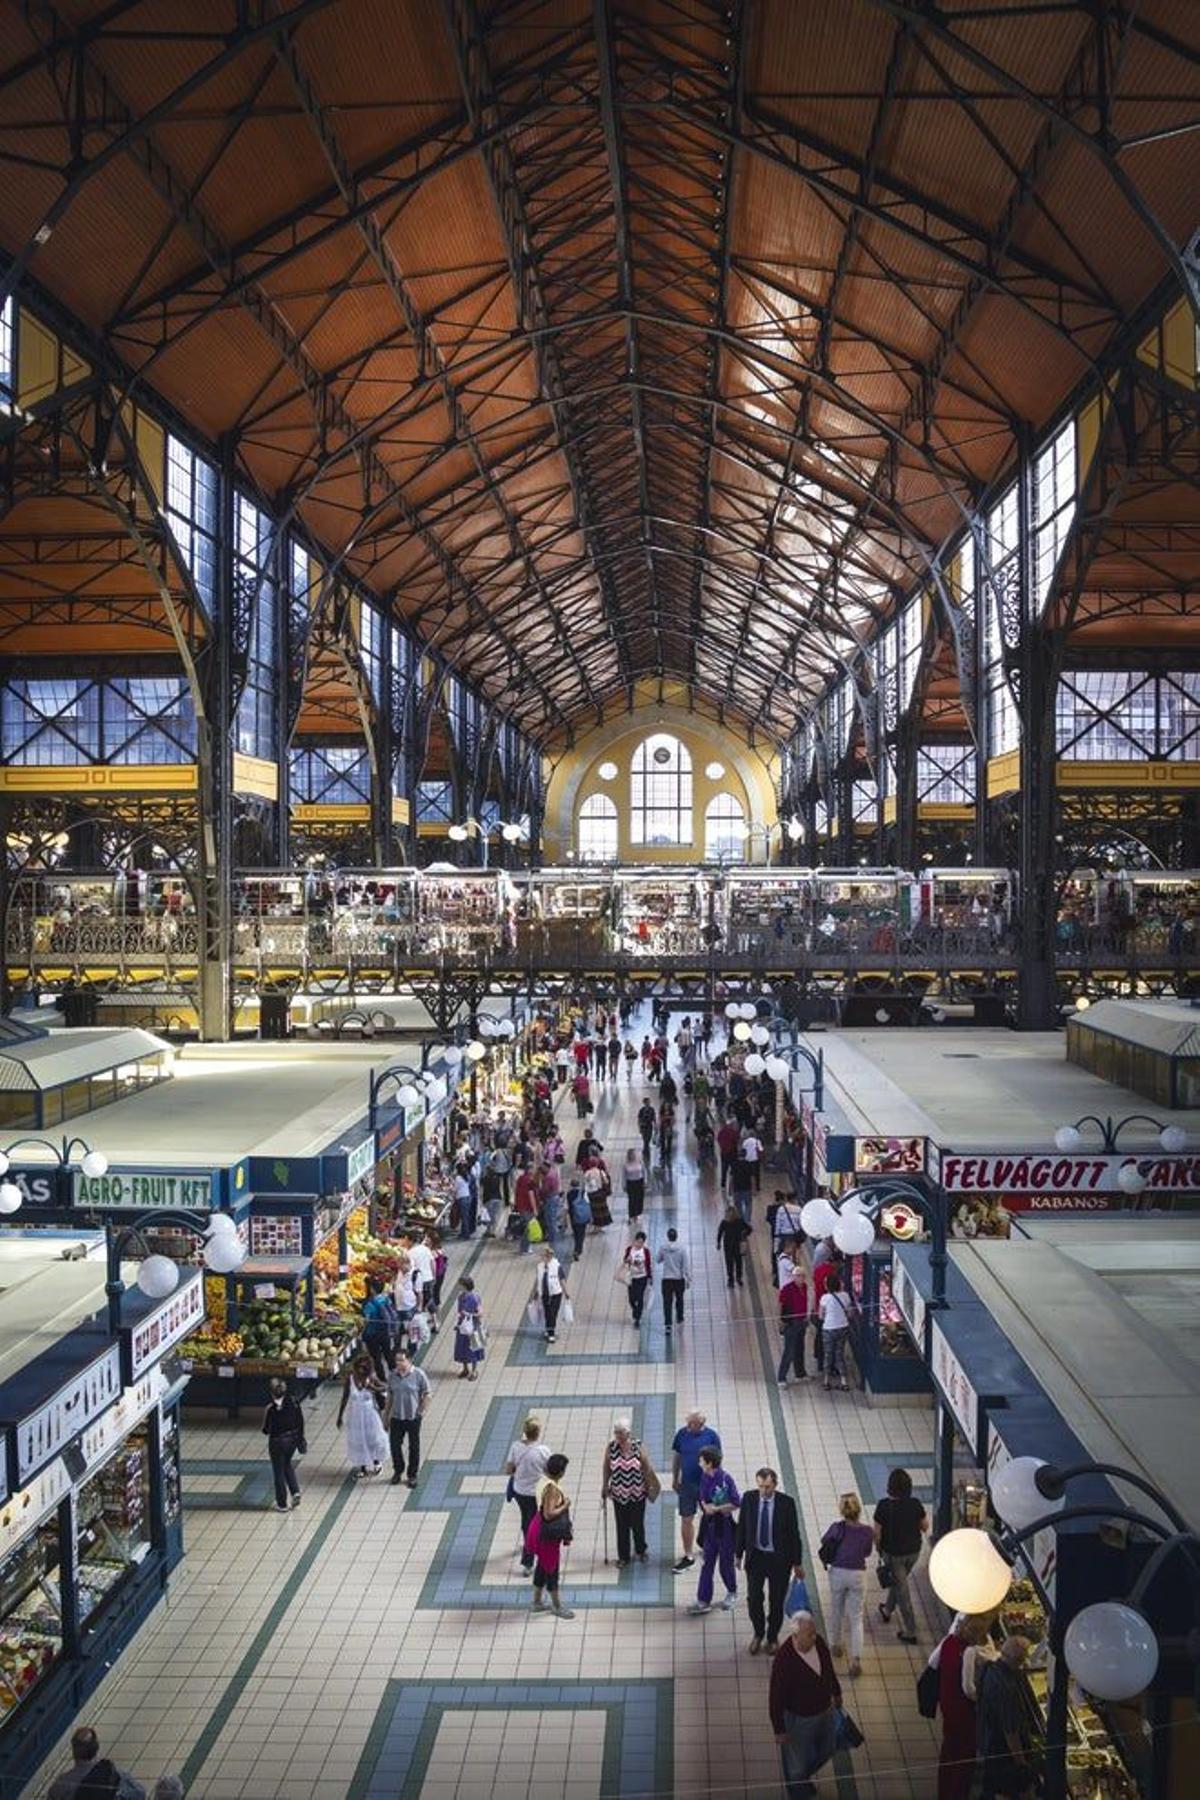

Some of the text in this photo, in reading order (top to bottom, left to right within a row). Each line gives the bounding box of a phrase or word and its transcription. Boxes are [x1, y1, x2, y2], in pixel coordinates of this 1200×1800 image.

[945, 1156, 1109, 1189] FELVÁGOTT
[79, 1176, 177, 1205] AGRO-FRUIT
[1030, 1197, 1109, 1209] KABANOS
